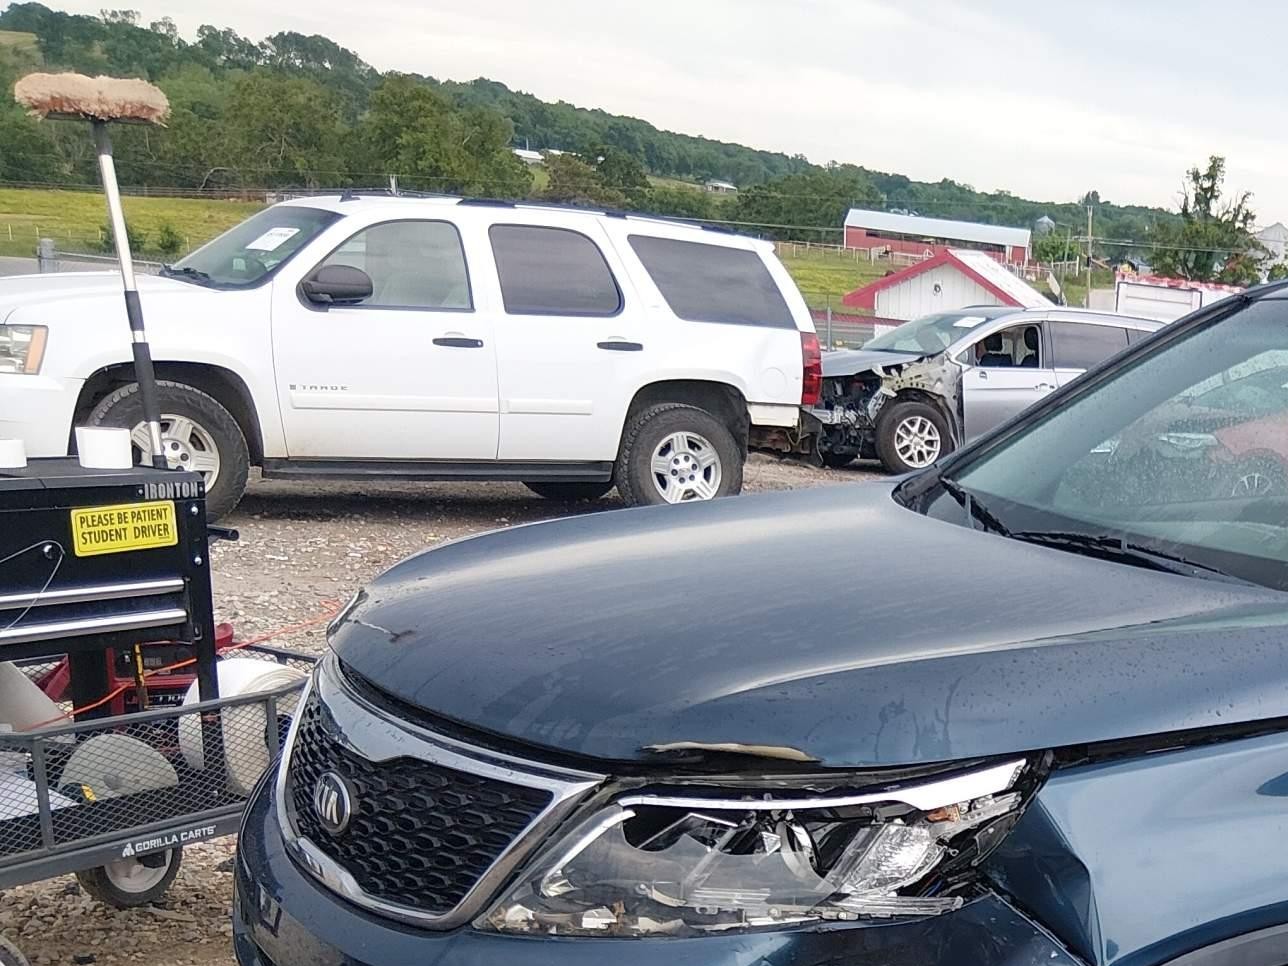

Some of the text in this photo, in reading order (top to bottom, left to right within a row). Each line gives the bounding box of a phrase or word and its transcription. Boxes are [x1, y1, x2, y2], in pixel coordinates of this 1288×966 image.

[144, 481, 199, 500] IRONTON
[79, 507, 168, 529] PLEASE BE PATIENT
[81, 523, 170, 545] STUDENT DRIVER
[135, 826, 215, 853] GORILLA CARTS
